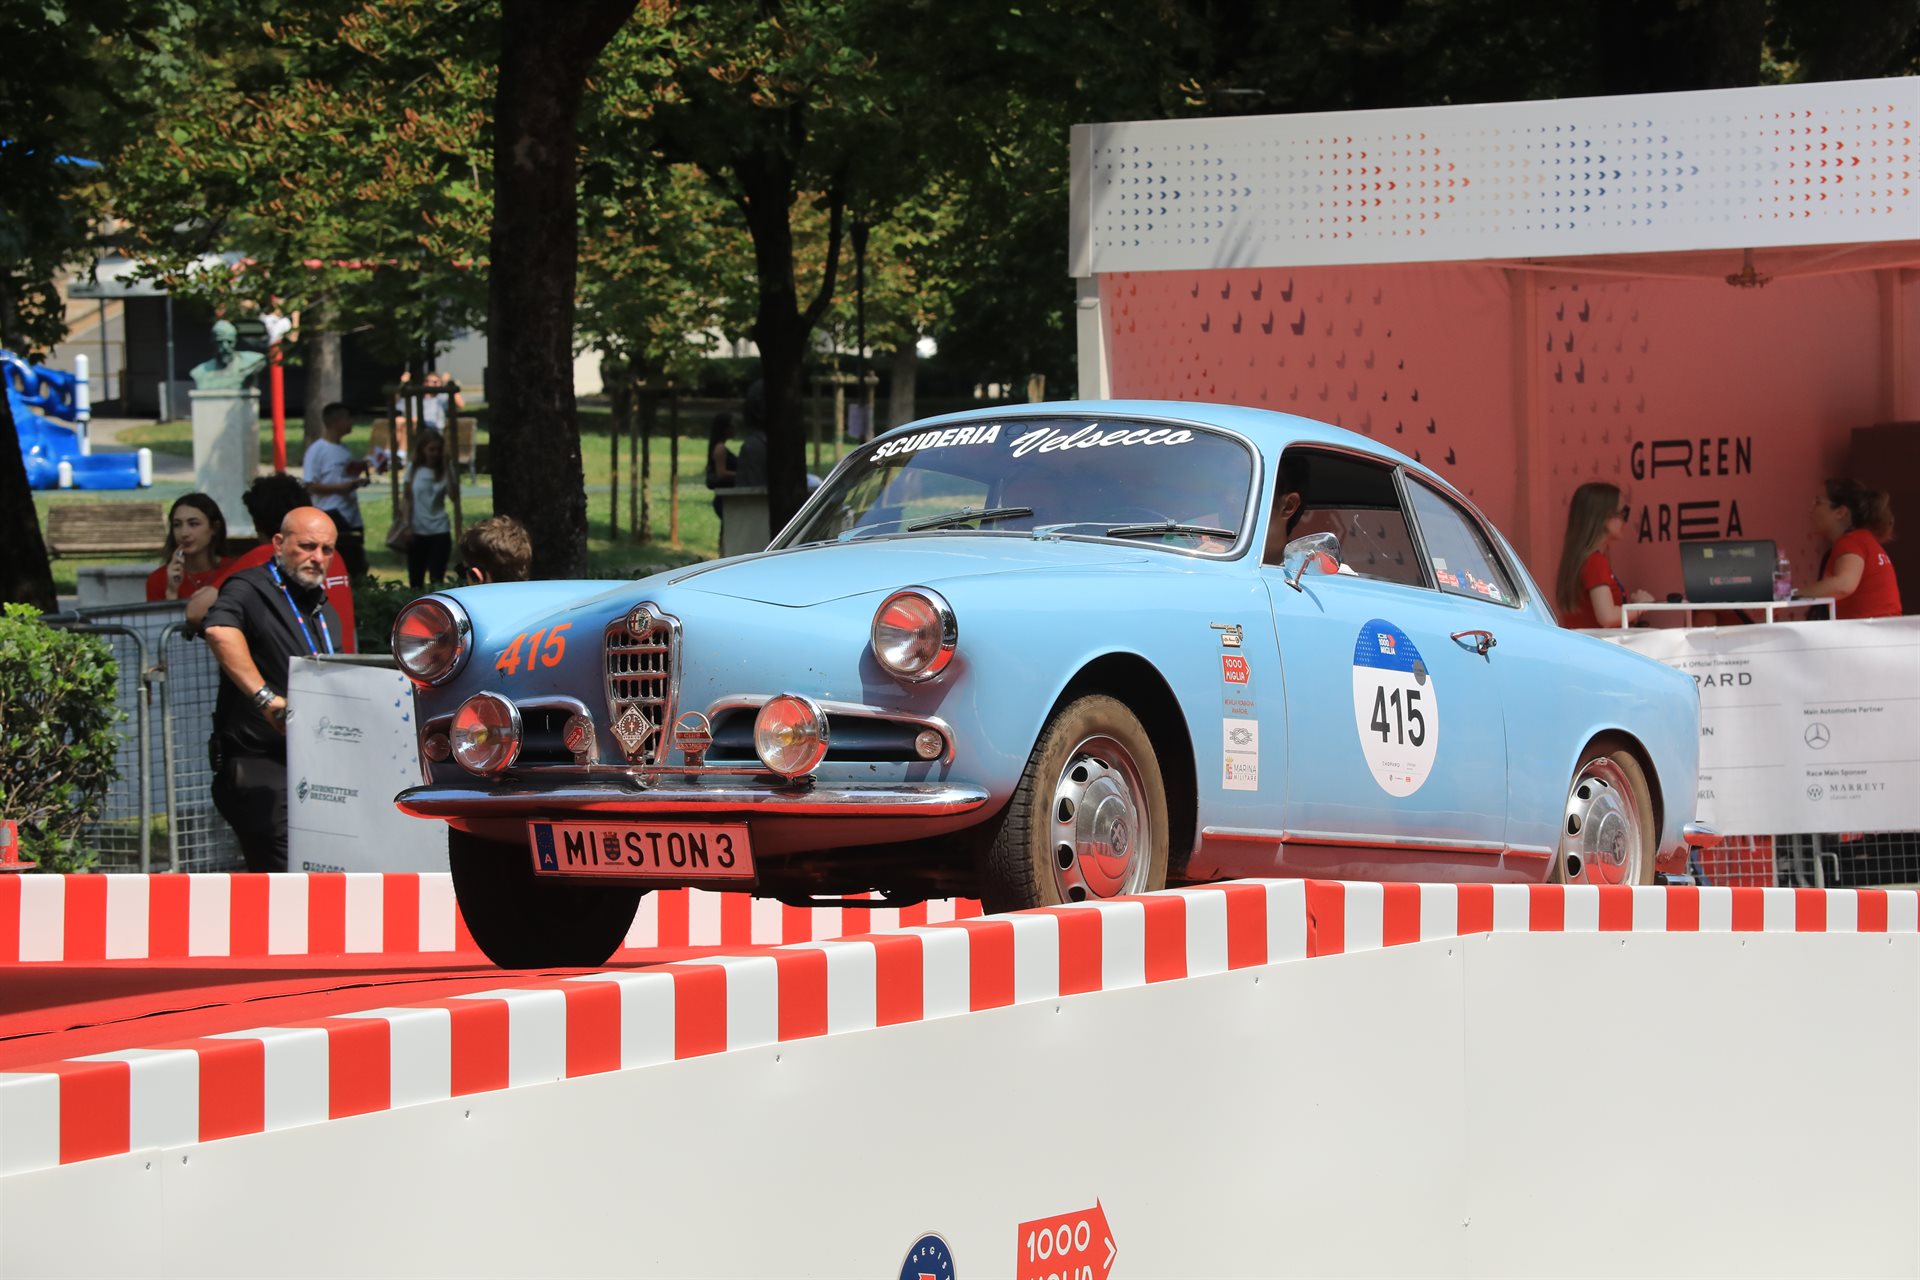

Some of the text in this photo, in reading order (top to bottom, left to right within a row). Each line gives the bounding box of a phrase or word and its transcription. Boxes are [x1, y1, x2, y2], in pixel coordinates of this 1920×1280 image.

[870, 423, 1194, 462] SCUDERIA Velsecco
[1631, 437, 1751, 480] GREEN
[1638, 500, 1743, 543] AREA
[496, 623, 571, 675] 415
[1226, 660, 1243, 669] 1000
[1713, 659, 1750, 667] Timekeeper
[1820, 706, 1857, 714] Automotive
[1371, 686, 1425, 747] 415
[1700, 728, 1714, 736] IN
[1233, 764, 1256, 773] MARINA
[1841, 769, 1867, 777] Sponsor
[311, 784, 358, 797] RUBINETTERIE
[1830, 783, 1885, 792] MARREYT
[310, 792, 346, 804] BRESCIANE
[564, 831, 598, 866] MI
[544, 855, 553, 864] A
[1027, 1220, 1091, 1263] 1000
